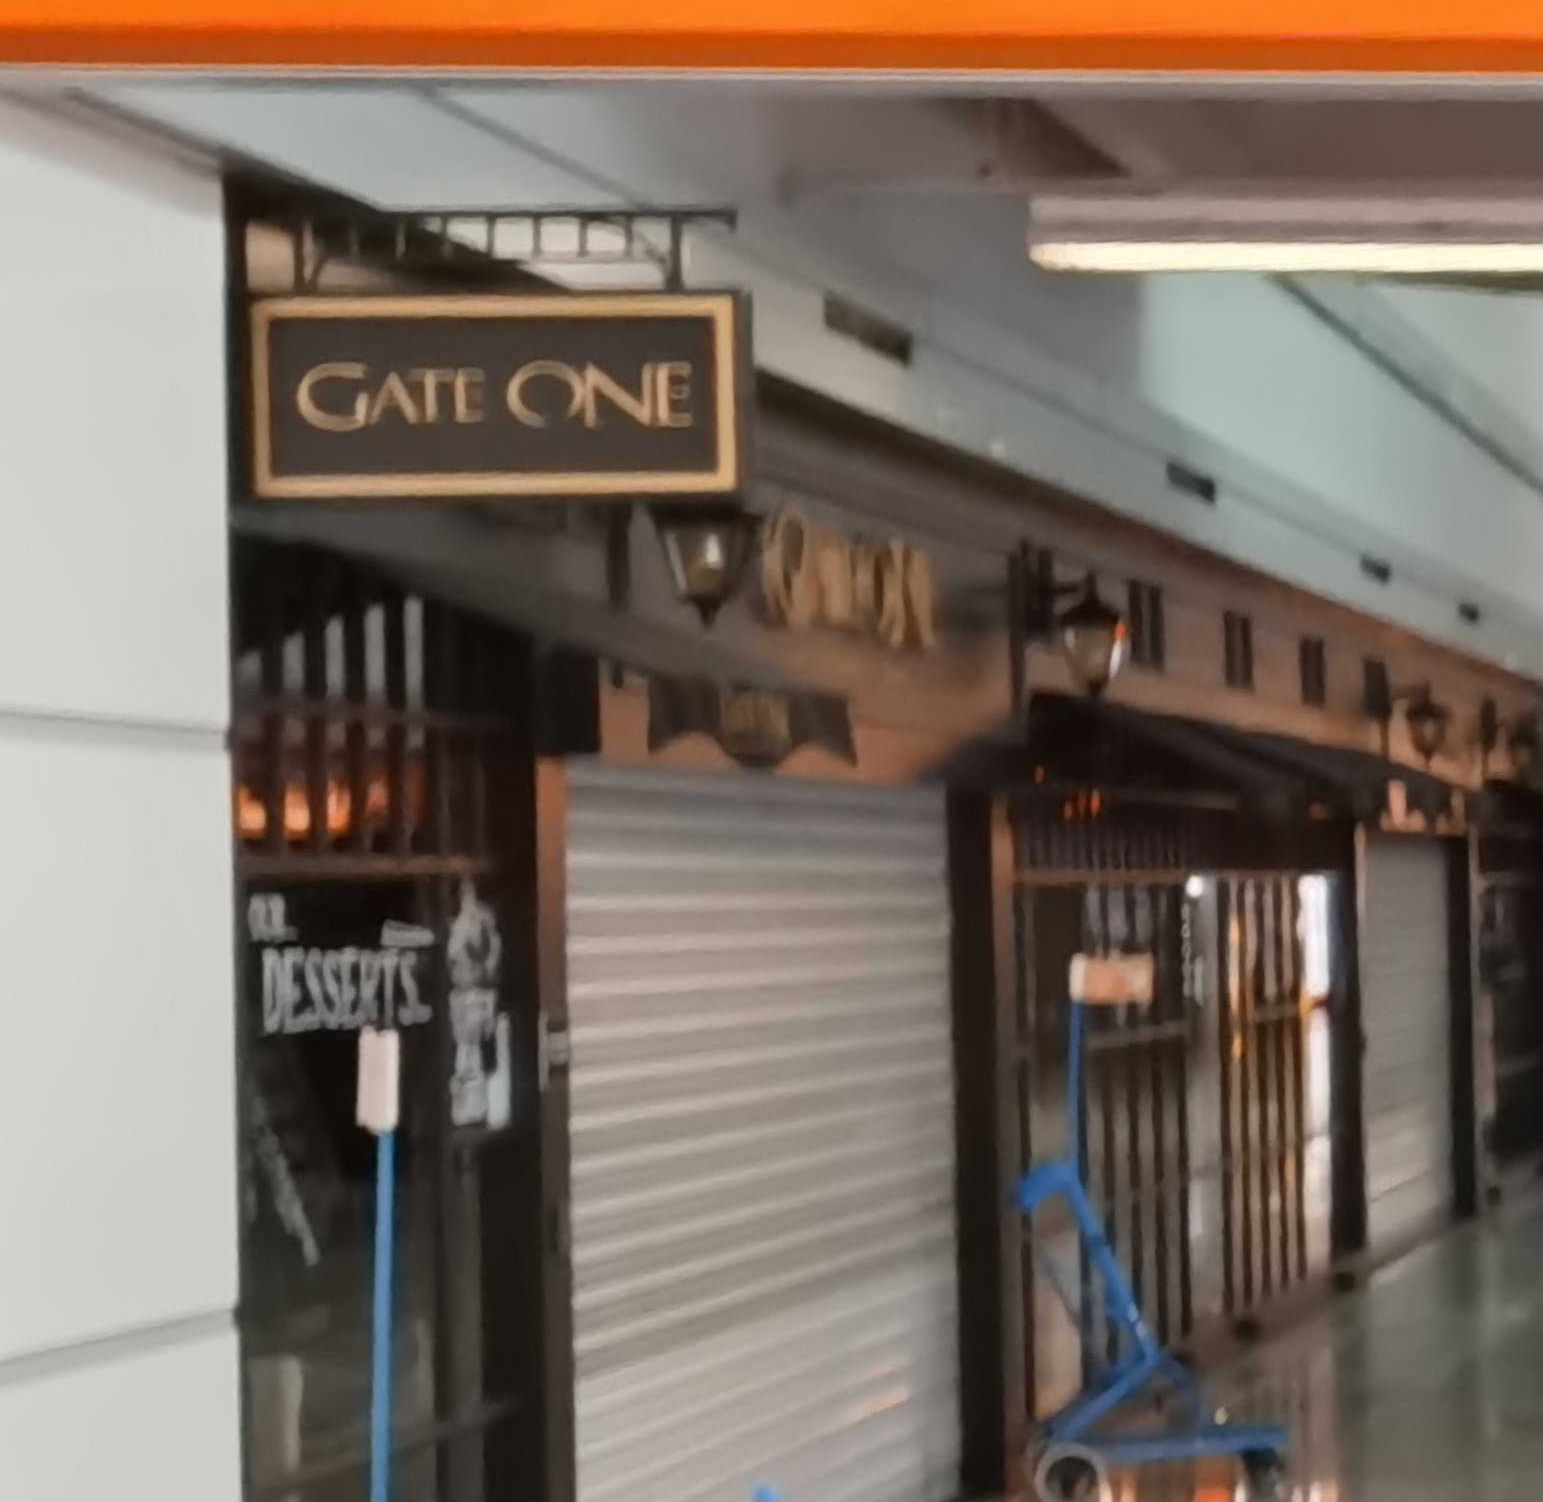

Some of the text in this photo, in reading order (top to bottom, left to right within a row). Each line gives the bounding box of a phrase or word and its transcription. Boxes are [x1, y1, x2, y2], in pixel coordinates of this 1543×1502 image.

[295, 357, 694, 432] GATE ONE
[260, 946, 434, 1035] DESSERTS
